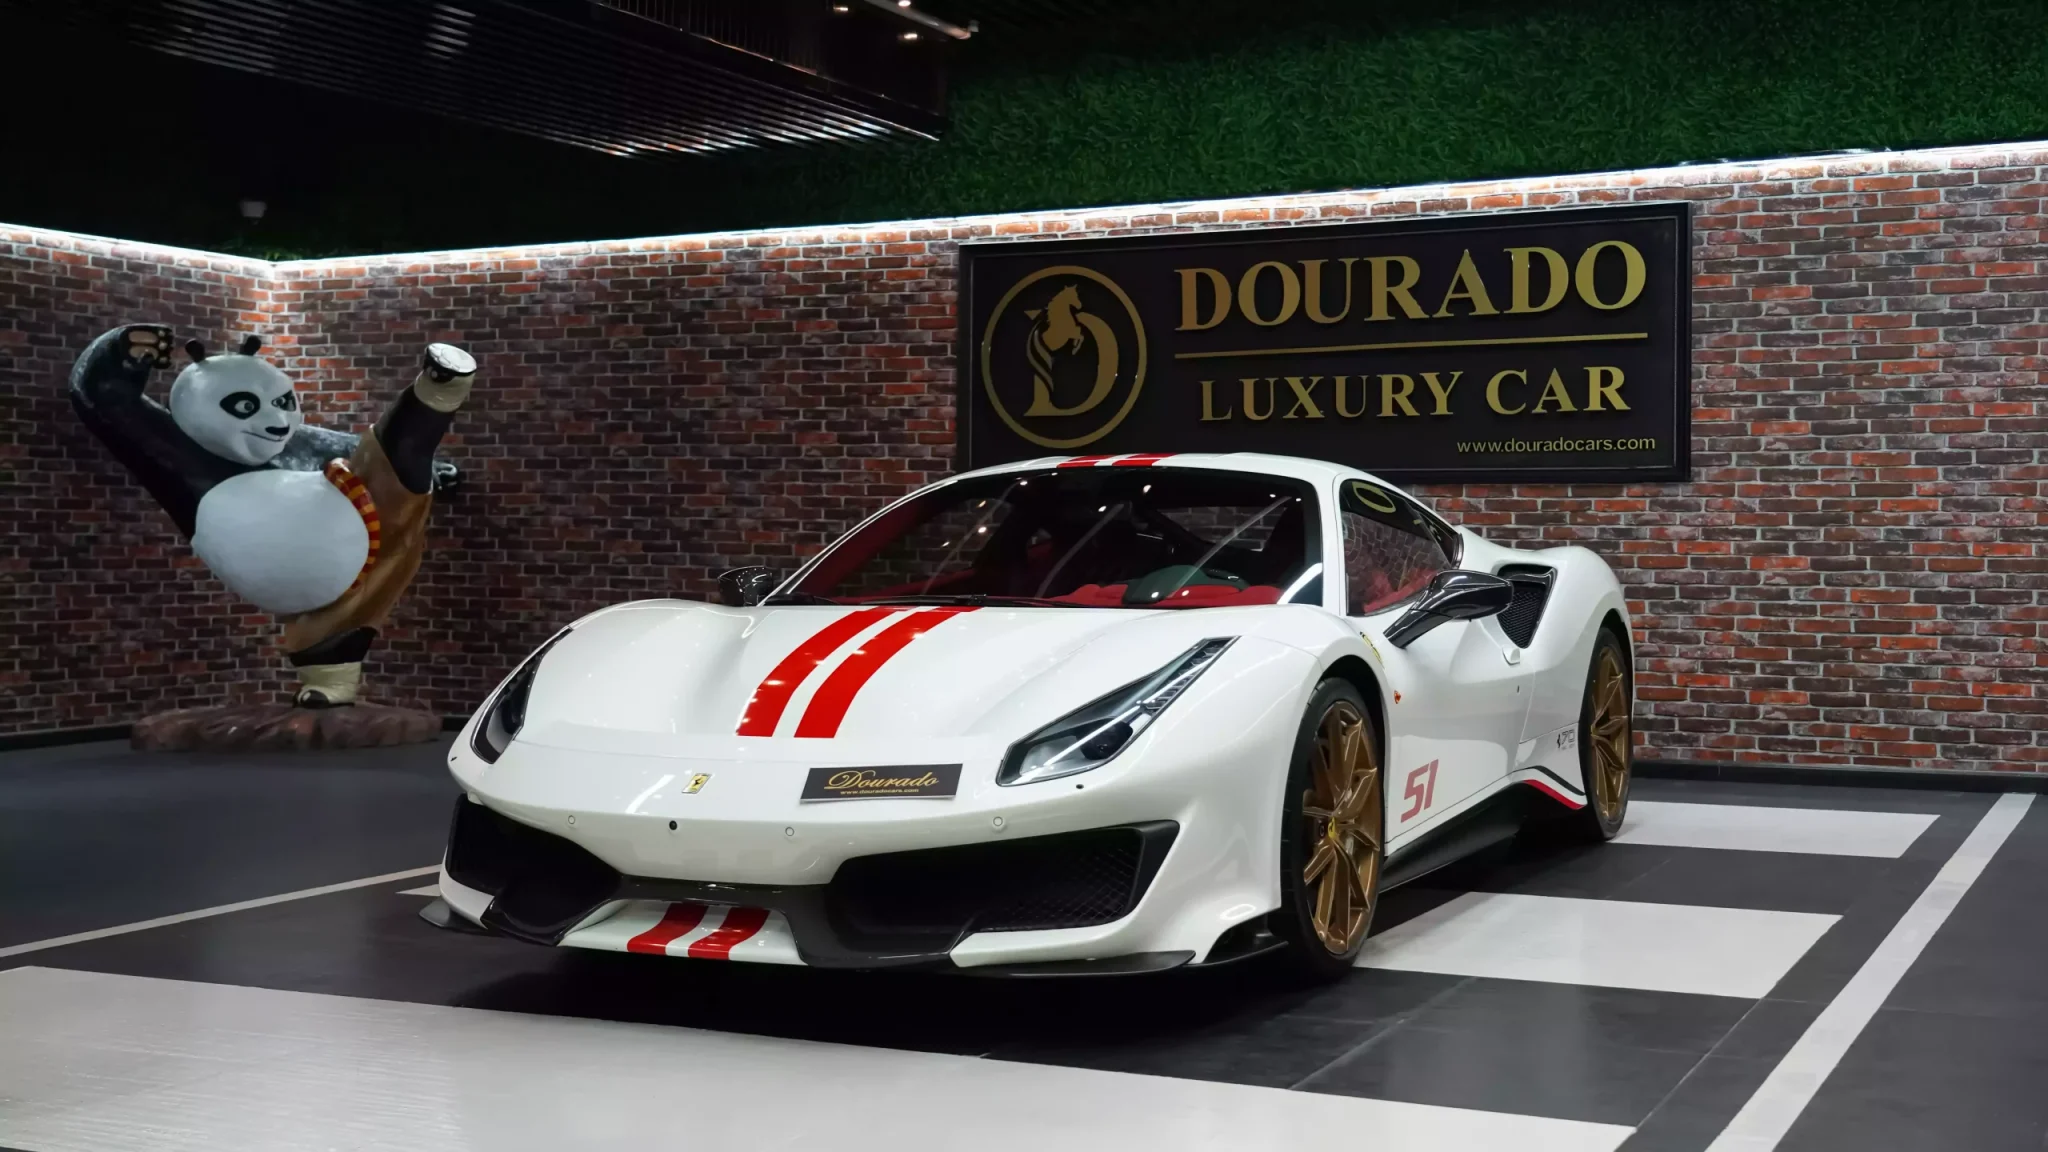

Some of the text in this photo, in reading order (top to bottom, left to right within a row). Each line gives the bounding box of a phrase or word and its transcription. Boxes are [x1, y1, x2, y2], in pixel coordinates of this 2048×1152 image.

[1173, 240, 1647, 331] DOURADO
[1199, 366, 1631, 421] LUXURY CAR
[1456, 436, 1656, 453] www.douradocars.com
[824, 769, 939, 790] Dourado
[1400, 758, 1439, 823] 51
